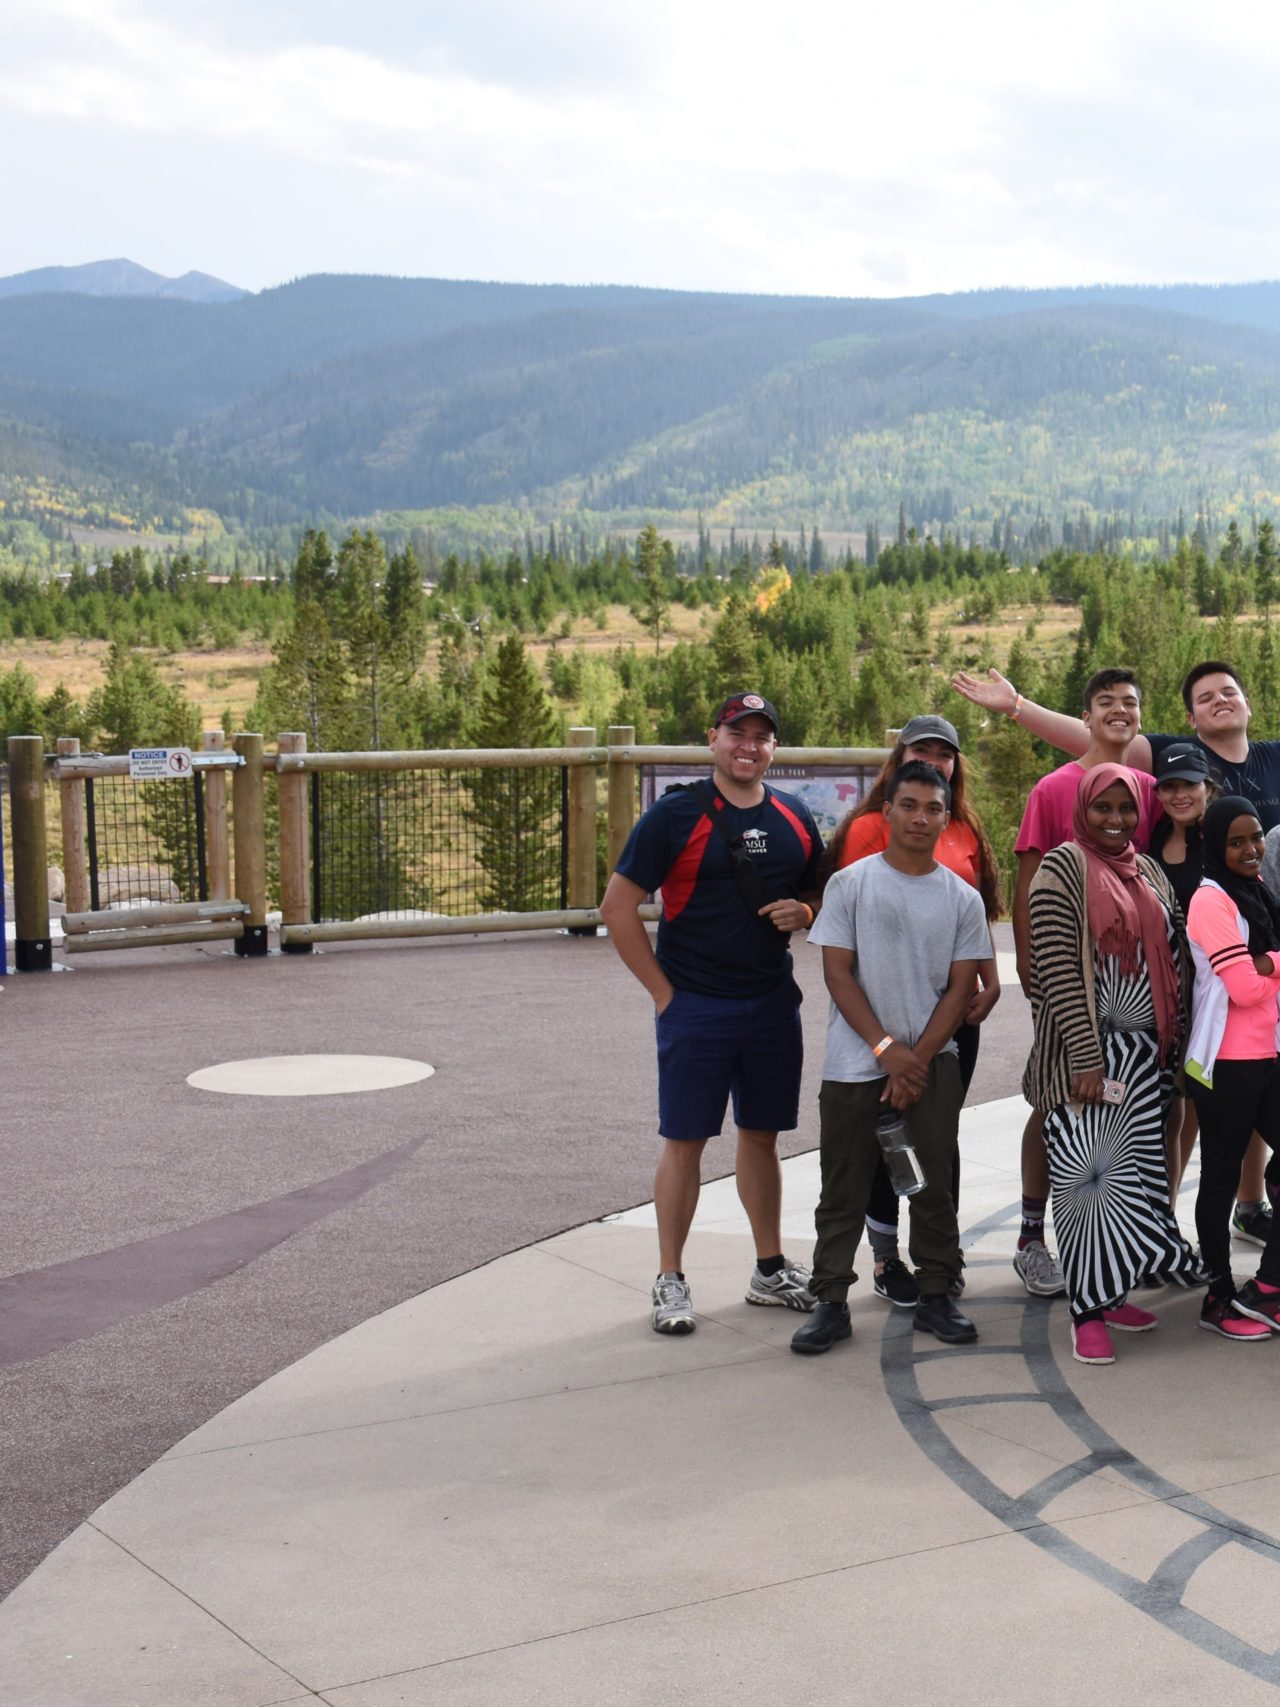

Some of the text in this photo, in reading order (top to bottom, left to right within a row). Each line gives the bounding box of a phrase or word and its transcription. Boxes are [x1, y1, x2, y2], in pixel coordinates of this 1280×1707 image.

[134, 751, 165, 759] NOTICE
[788, 768, 806, 777] PARK
[745, 839, 766, 849] MSU
